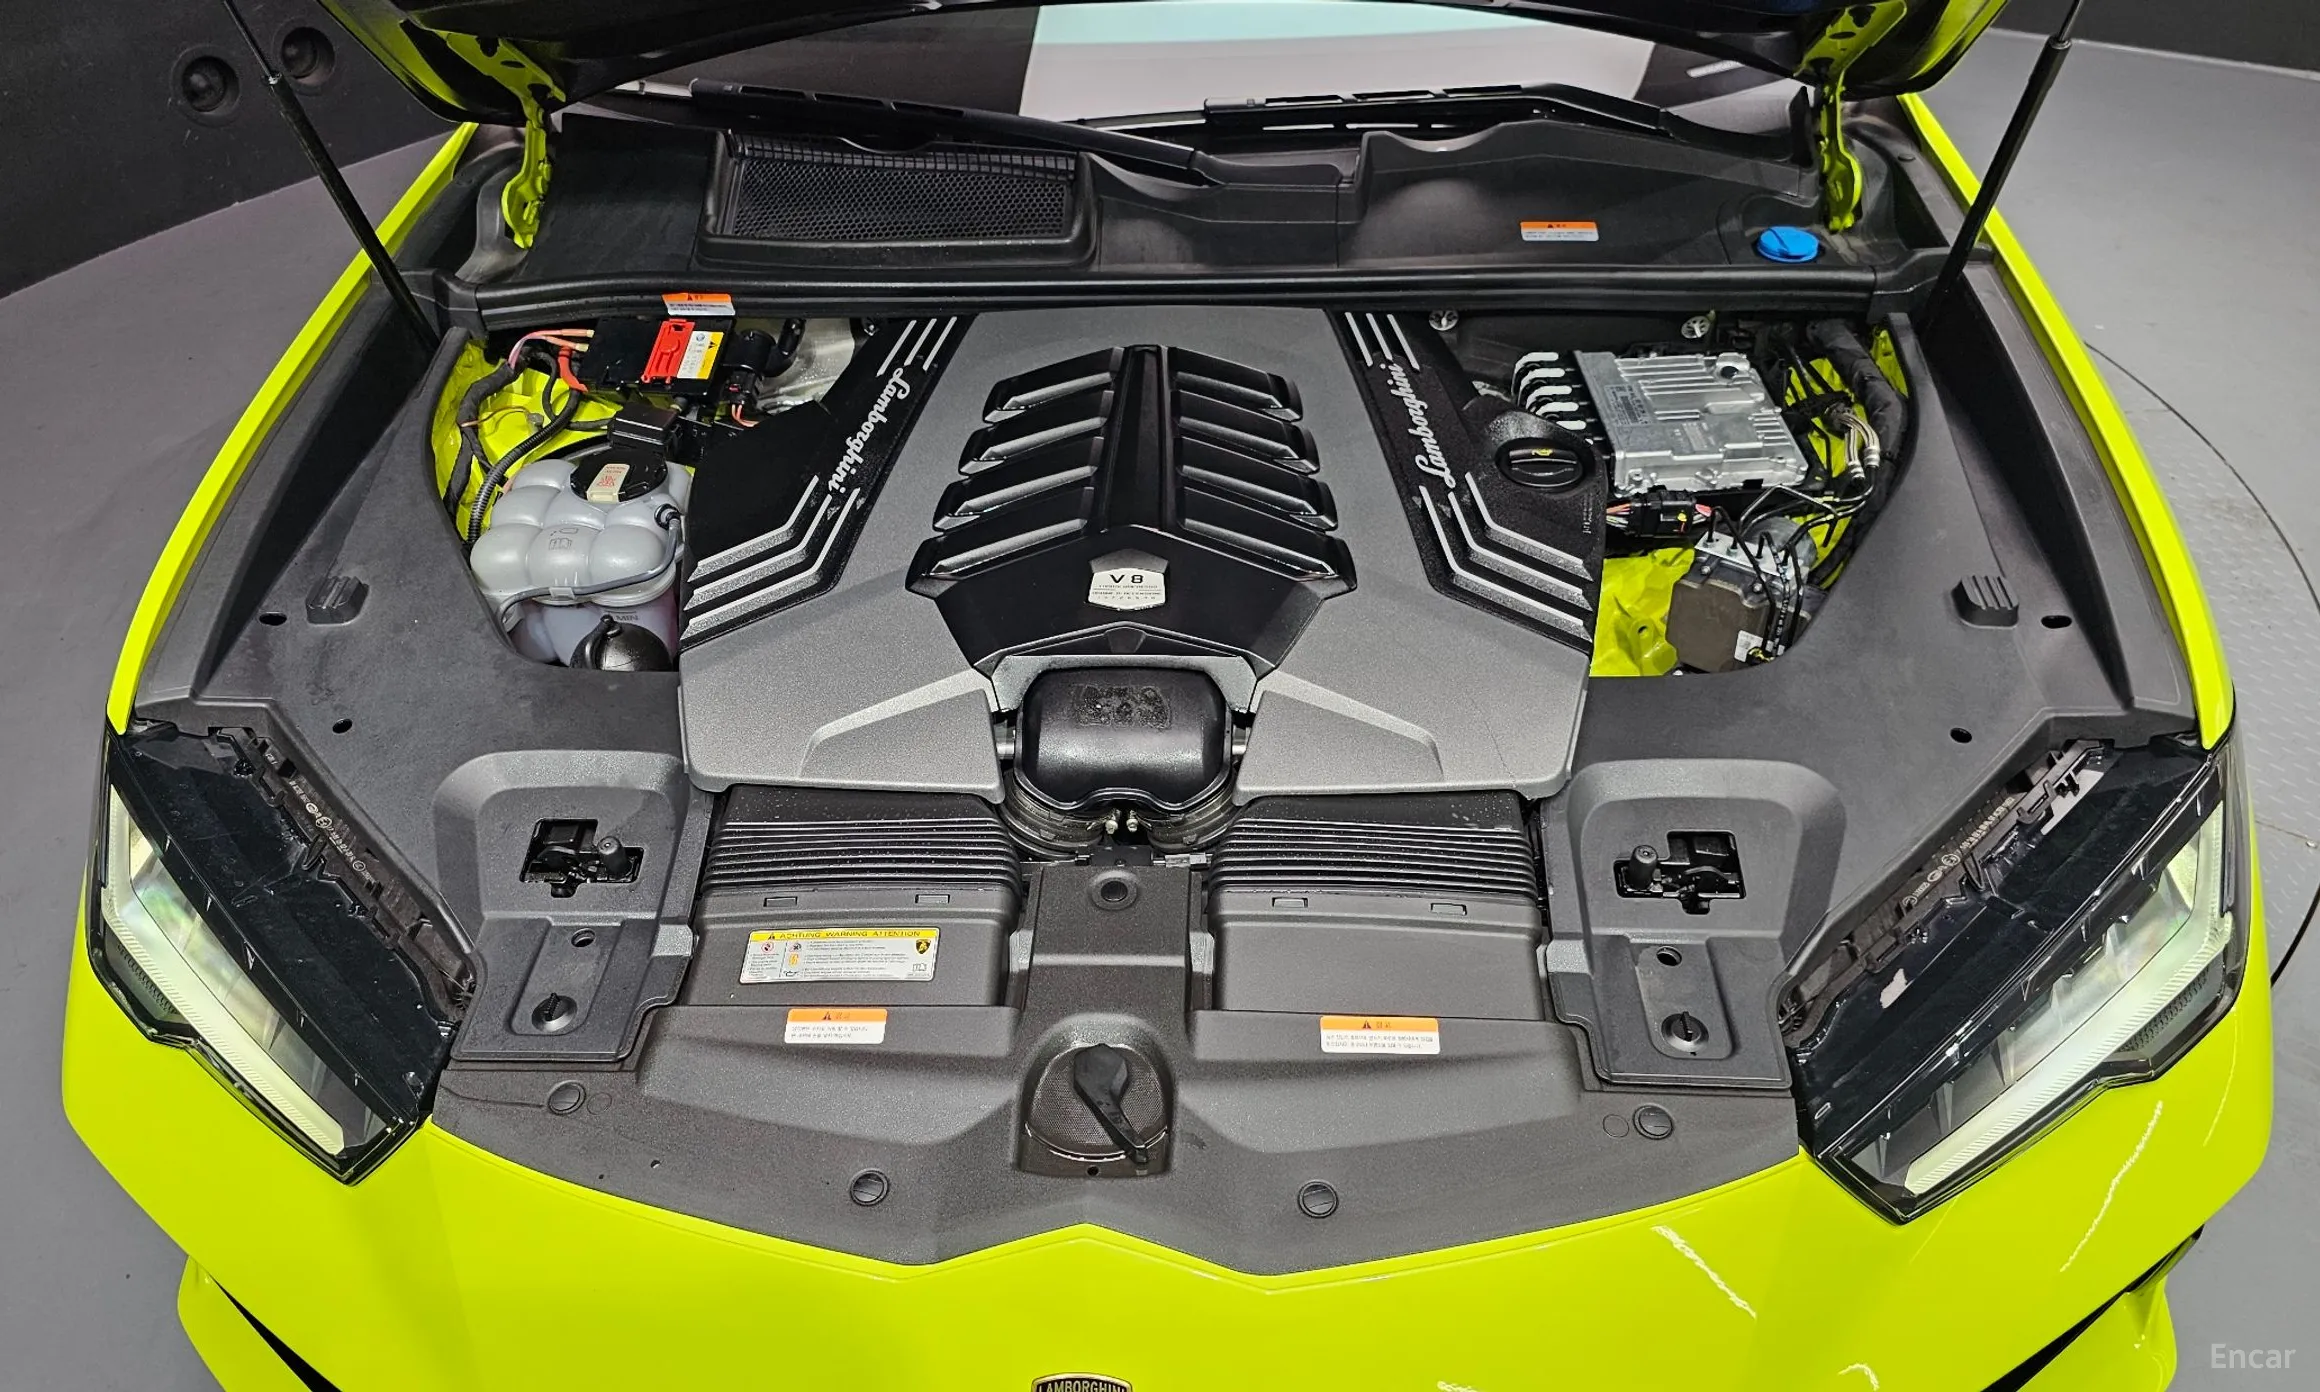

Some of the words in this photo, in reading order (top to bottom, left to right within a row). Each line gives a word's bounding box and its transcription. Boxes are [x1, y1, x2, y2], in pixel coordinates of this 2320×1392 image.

[828, 367, 911, 493] Lamborghini
[1380, 363, 1456, 489] Lamborghini
[779, 932, 821, 940] ACHTUNG
[1038, 1380, 1126, 1392] AMBORGHI
